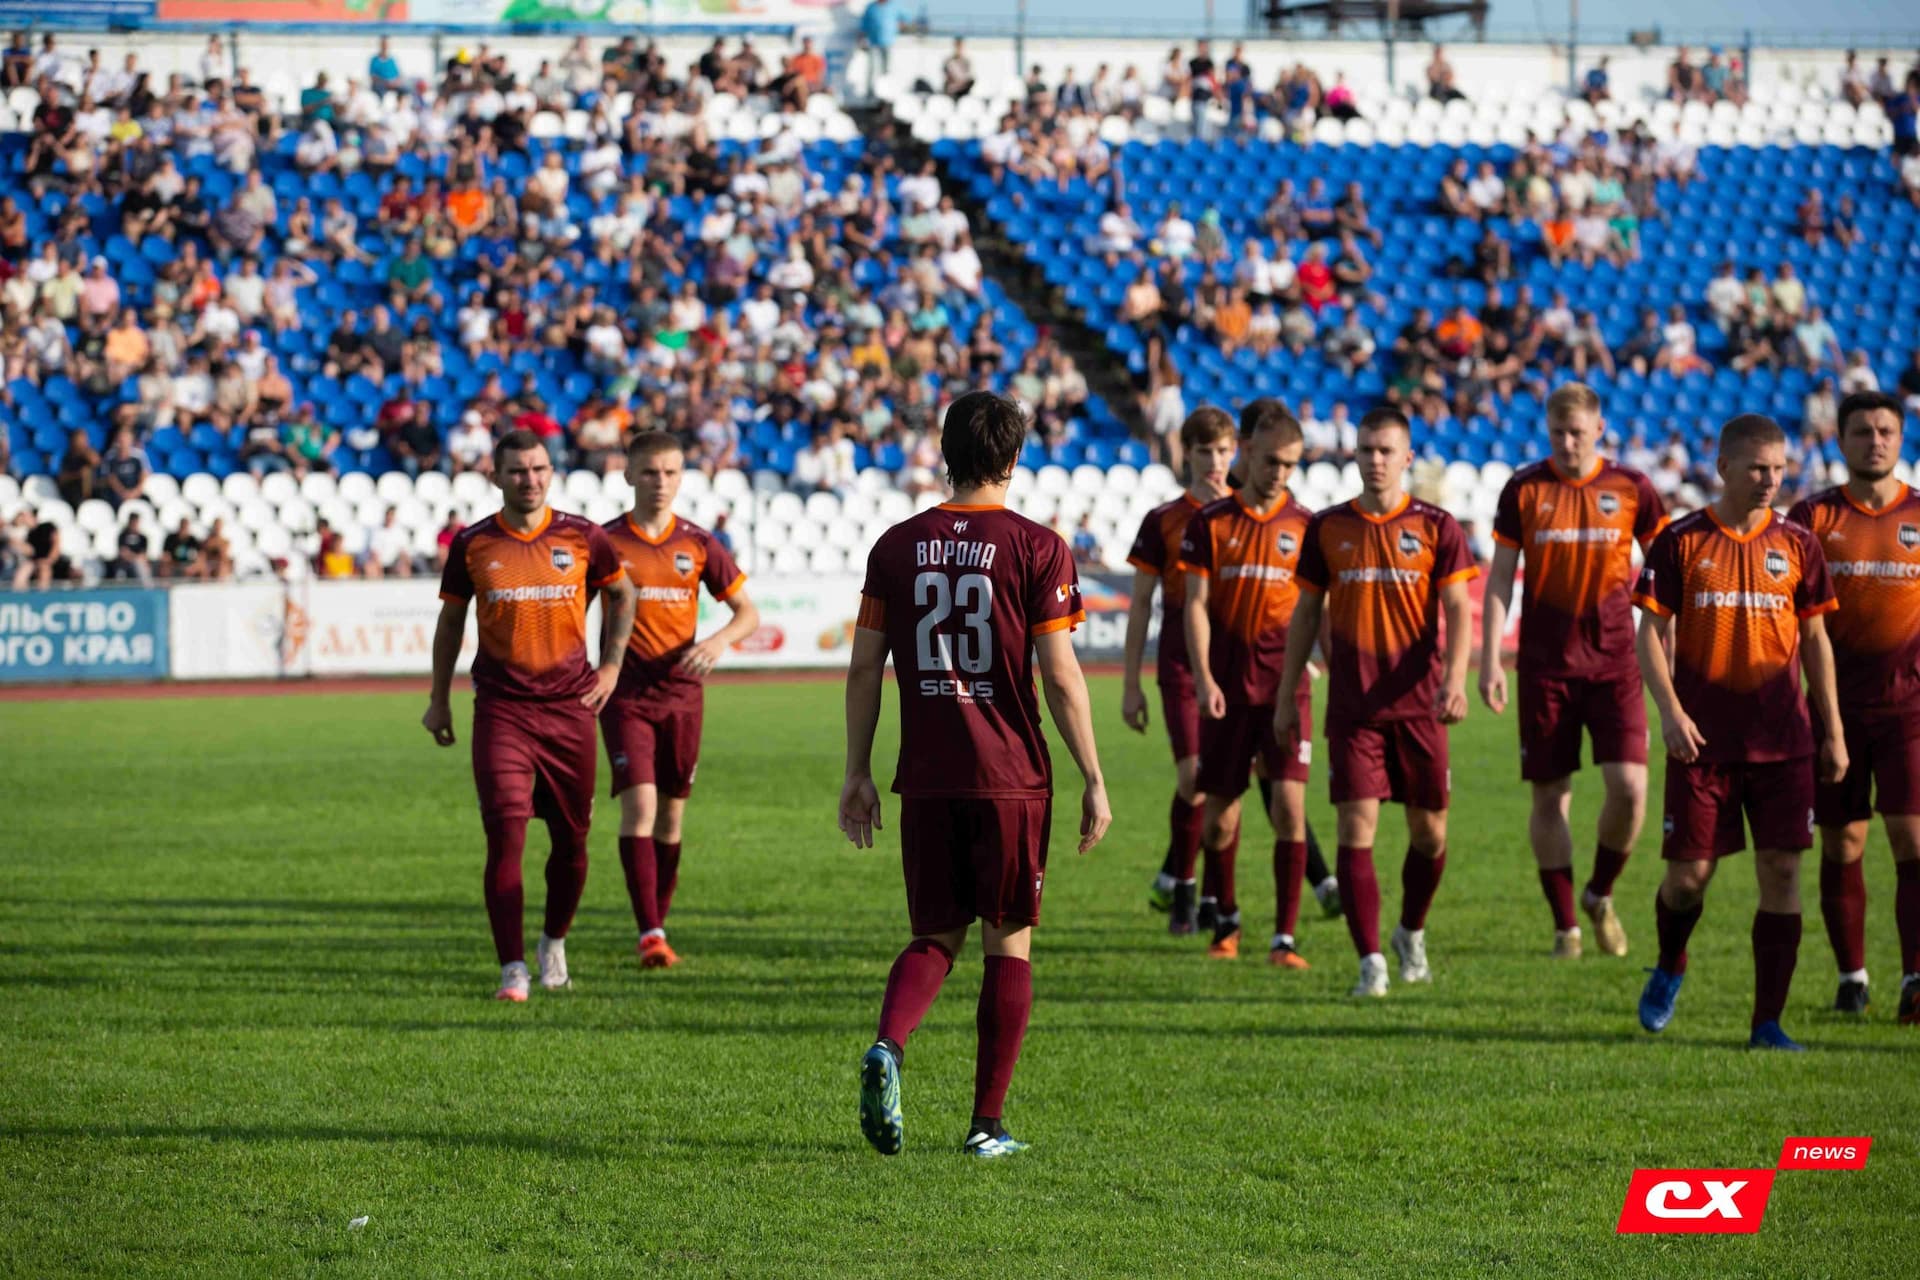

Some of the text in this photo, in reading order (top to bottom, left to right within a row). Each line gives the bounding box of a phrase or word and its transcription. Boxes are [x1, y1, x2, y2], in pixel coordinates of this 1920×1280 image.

[916, 539, 996, 569] ВОРОНА
[914, 571, 993, 674] 23
[0, 633, 154, 667] ГО КРАЯ
[920, 679, 994, 697] SEUS
